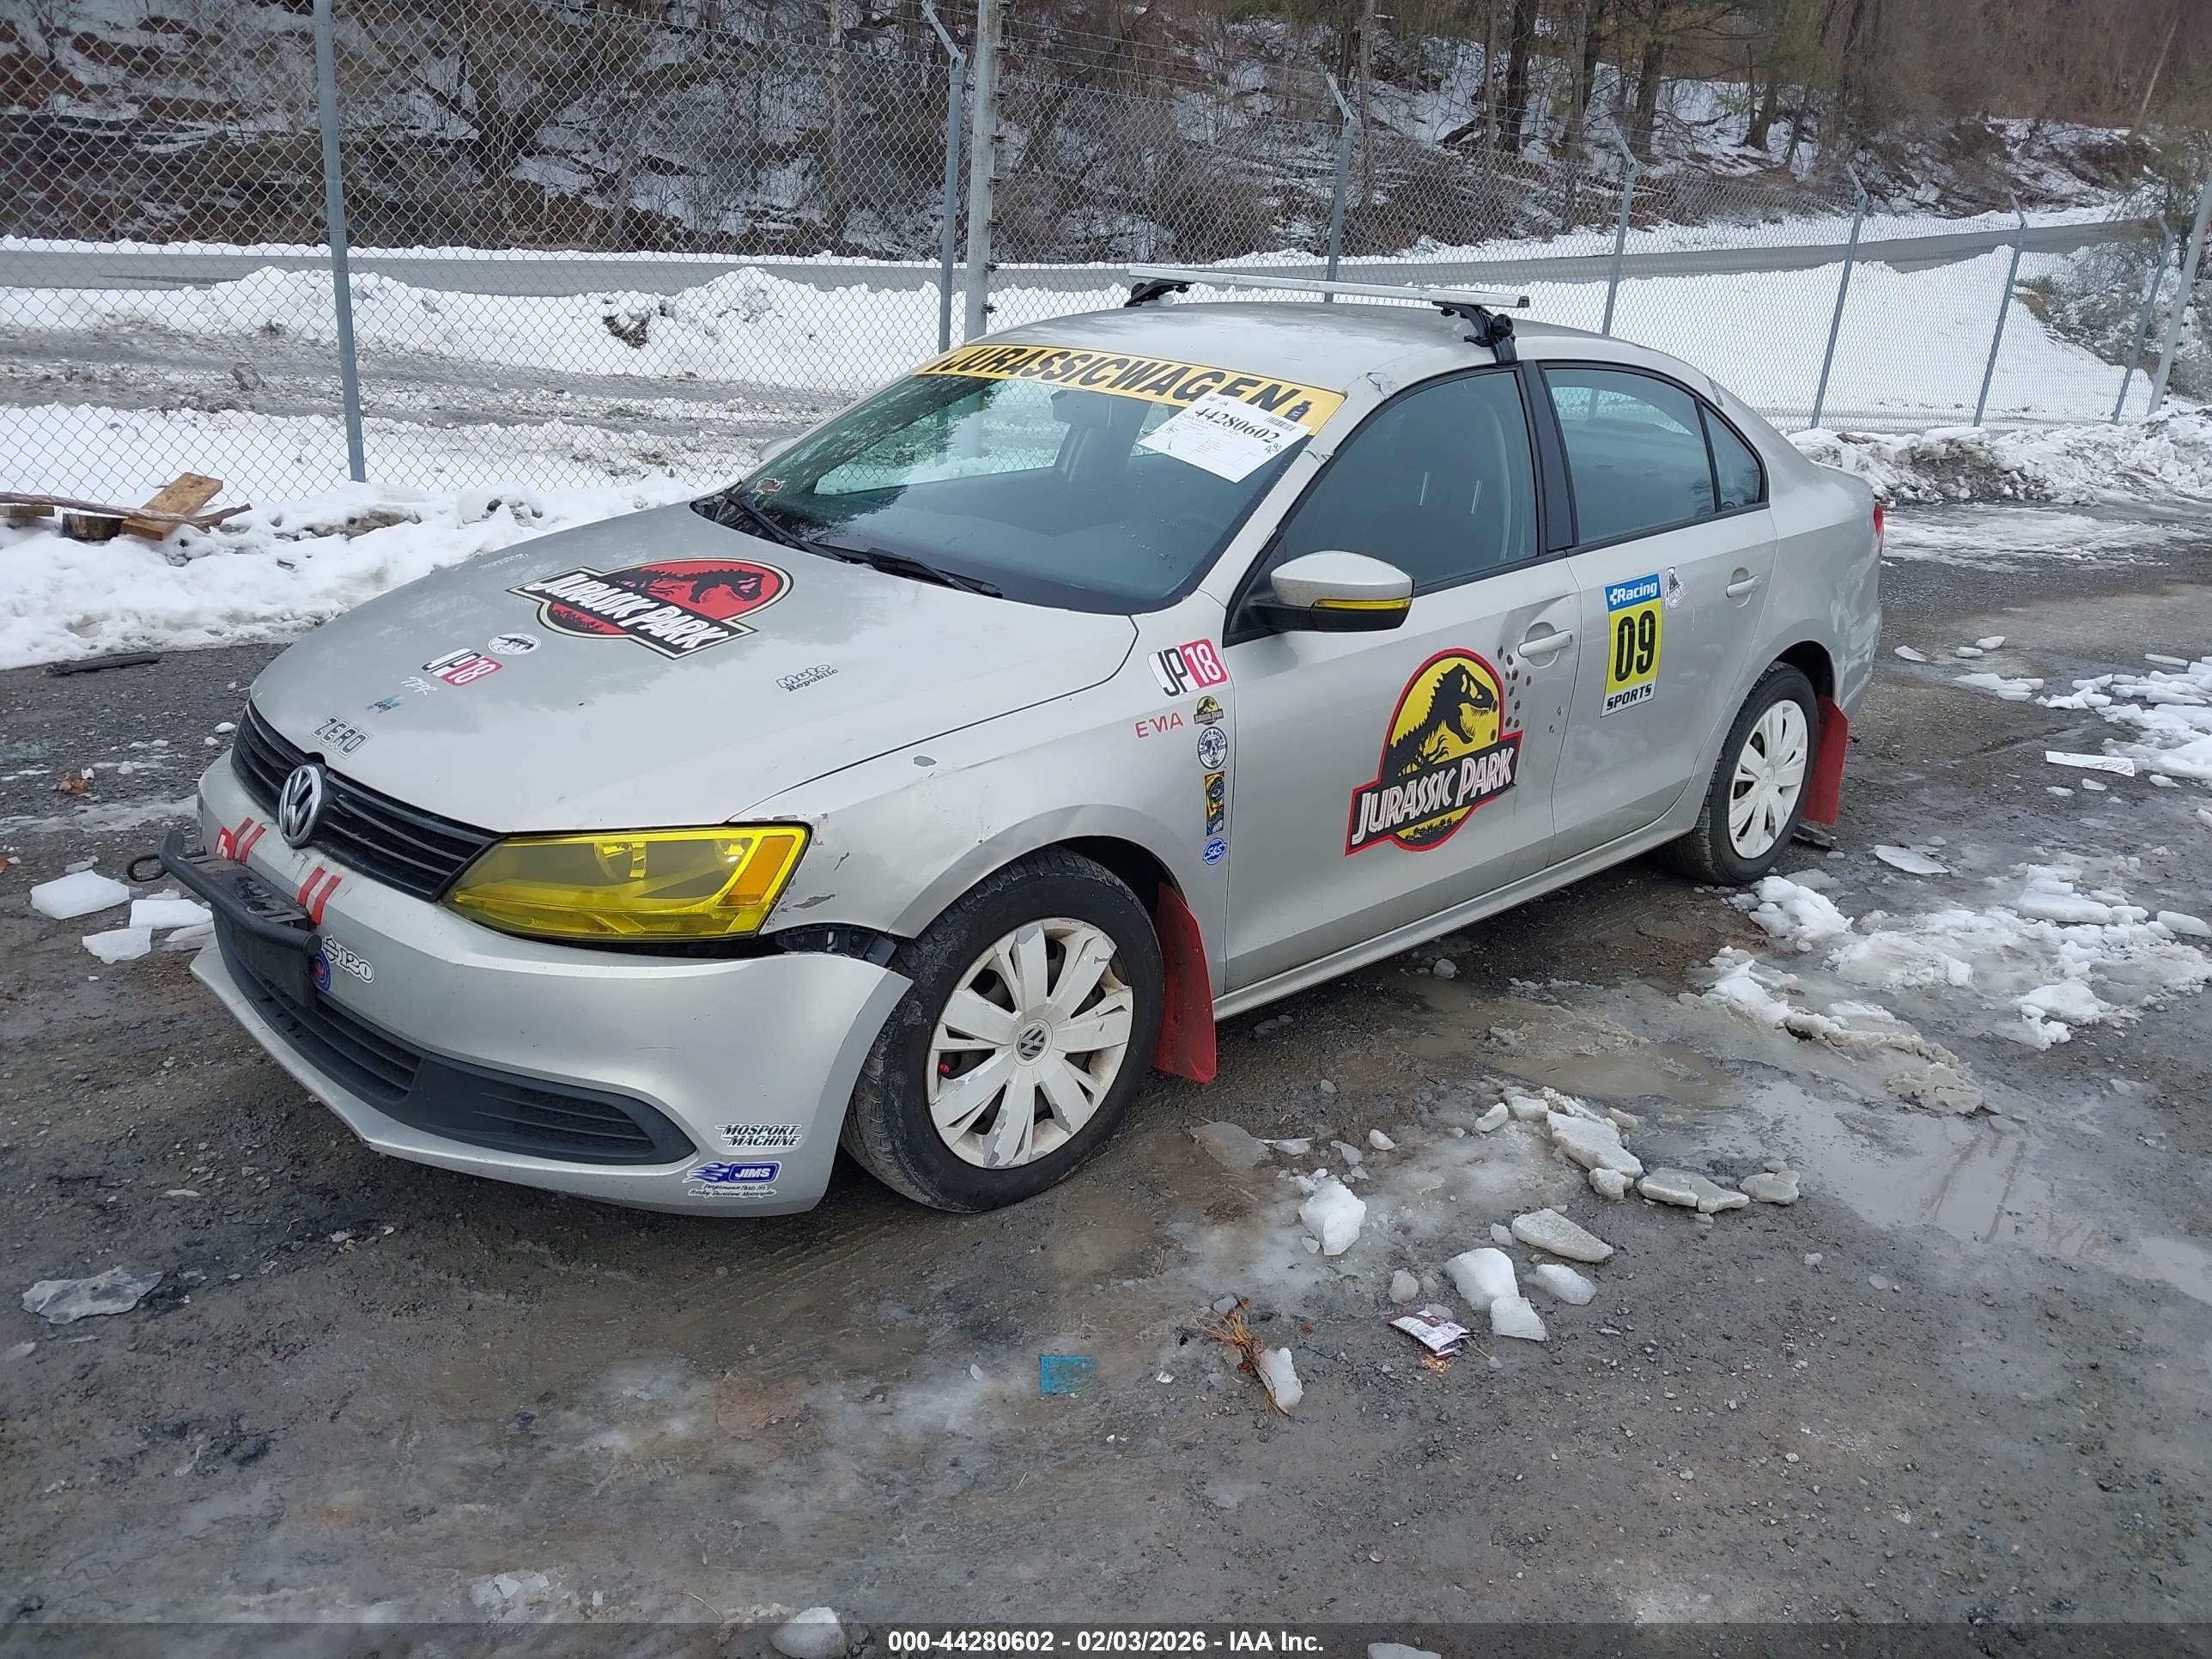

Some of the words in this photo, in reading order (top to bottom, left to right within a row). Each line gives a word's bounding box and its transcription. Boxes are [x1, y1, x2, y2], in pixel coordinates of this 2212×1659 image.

[938, 347, 1302, 413] JURASSICWAGEN
[1194, 407, 1280, 443] 44280602
[524, 573, 659, 620] JURASSIC
[617, 605, 730, 650] PARK
[1614, 609, 1656, 683] 09
[775, 664, 830, 689] Moto
[787, 669, 839, 692] Republic
[1606, 682, 1653, 712] SPORTS
[313, 716, 368, 756] ZERO
[1352, 767, 1457, 846] JURASSIC
[1455, 746, 1516, 808] PARK
[339, 947, 374, 981] 120
[717, 1124, 800, 1135] MOSPORT
[723, 1135, 800, 1146] MACHINE
[734, 1168, 771, 1178] JIMS
